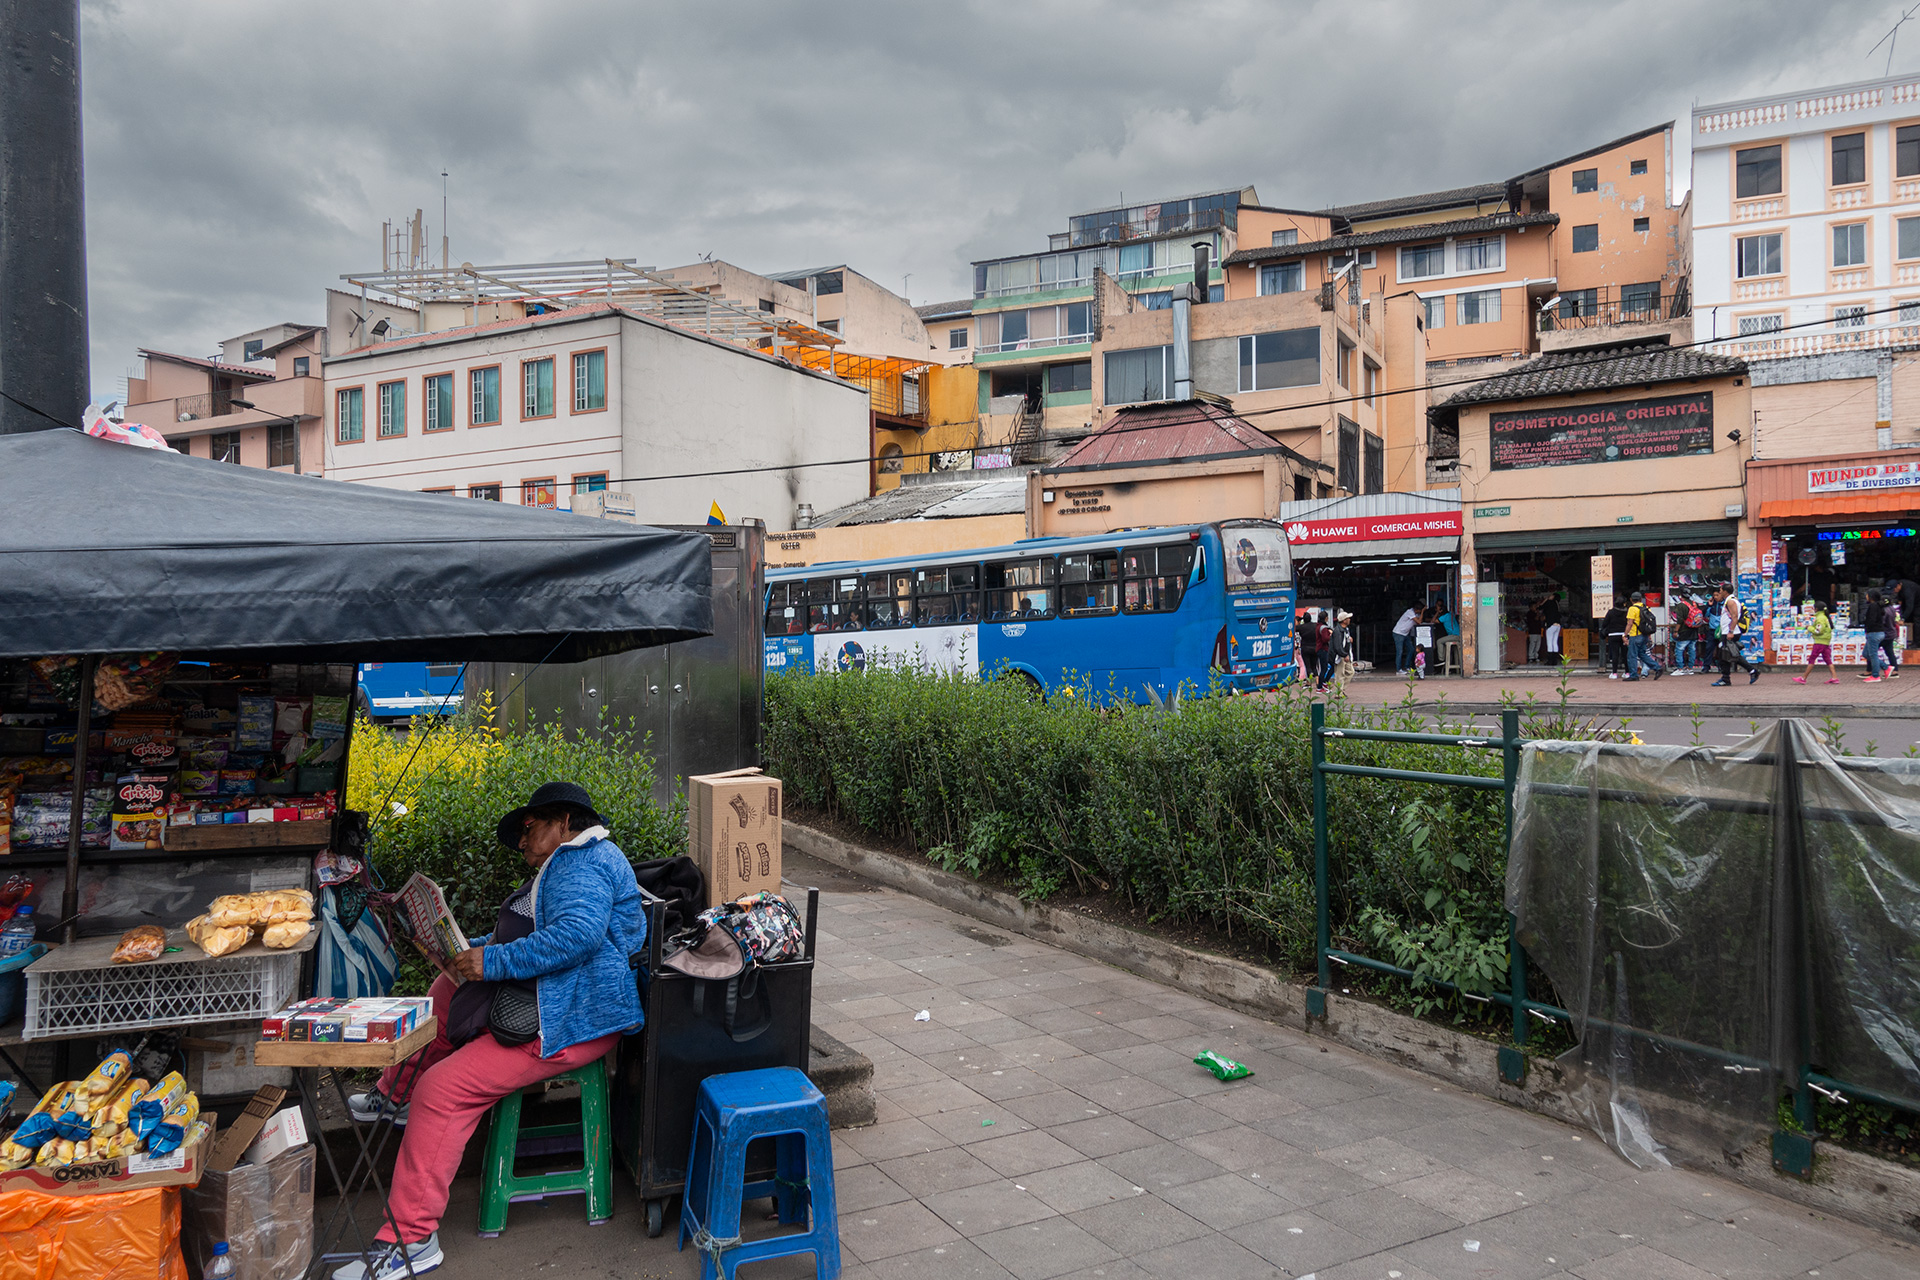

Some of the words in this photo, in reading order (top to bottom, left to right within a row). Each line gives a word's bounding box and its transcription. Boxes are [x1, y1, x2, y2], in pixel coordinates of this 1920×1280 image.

[1494, 410, 1616, 432] COSMETOLOGÍA
[1626, 402, 1708, 420] ORIENTAL
[1616, 435, 1680, 446] ADELGAZAMIENTO
[1623, 444, 1679, 455] 085180886
[1811, 467, 1877, 487] MUNDO
[1885, 464, 1910, 474] DE
[1846, 481, 1859, 489] DE
[1862, 477, 1911, 487] DIVERSOS
[1312, 526, 1357, 537] HUAWEI
[1371, 522, 1422, 534] COMERCIAL
[1424, 520, 1457, 530] MISHEL
[781, 542, 800, 550] OSTER
[1252, 640, 1272, 657] 1215
[766, 652, 786, 667] 1215
[111, 733, 153, 749] Manicho
[132, 742, 176, 758] Grissly
[247, 771, 256, 779] 70
[119, 784, 163, 802] Grissly
[418, 877, 444, 916] EXTRA
[314, 1024, 335, 1036] Caribe
[54, 1160, 121, 1182] TANGO
